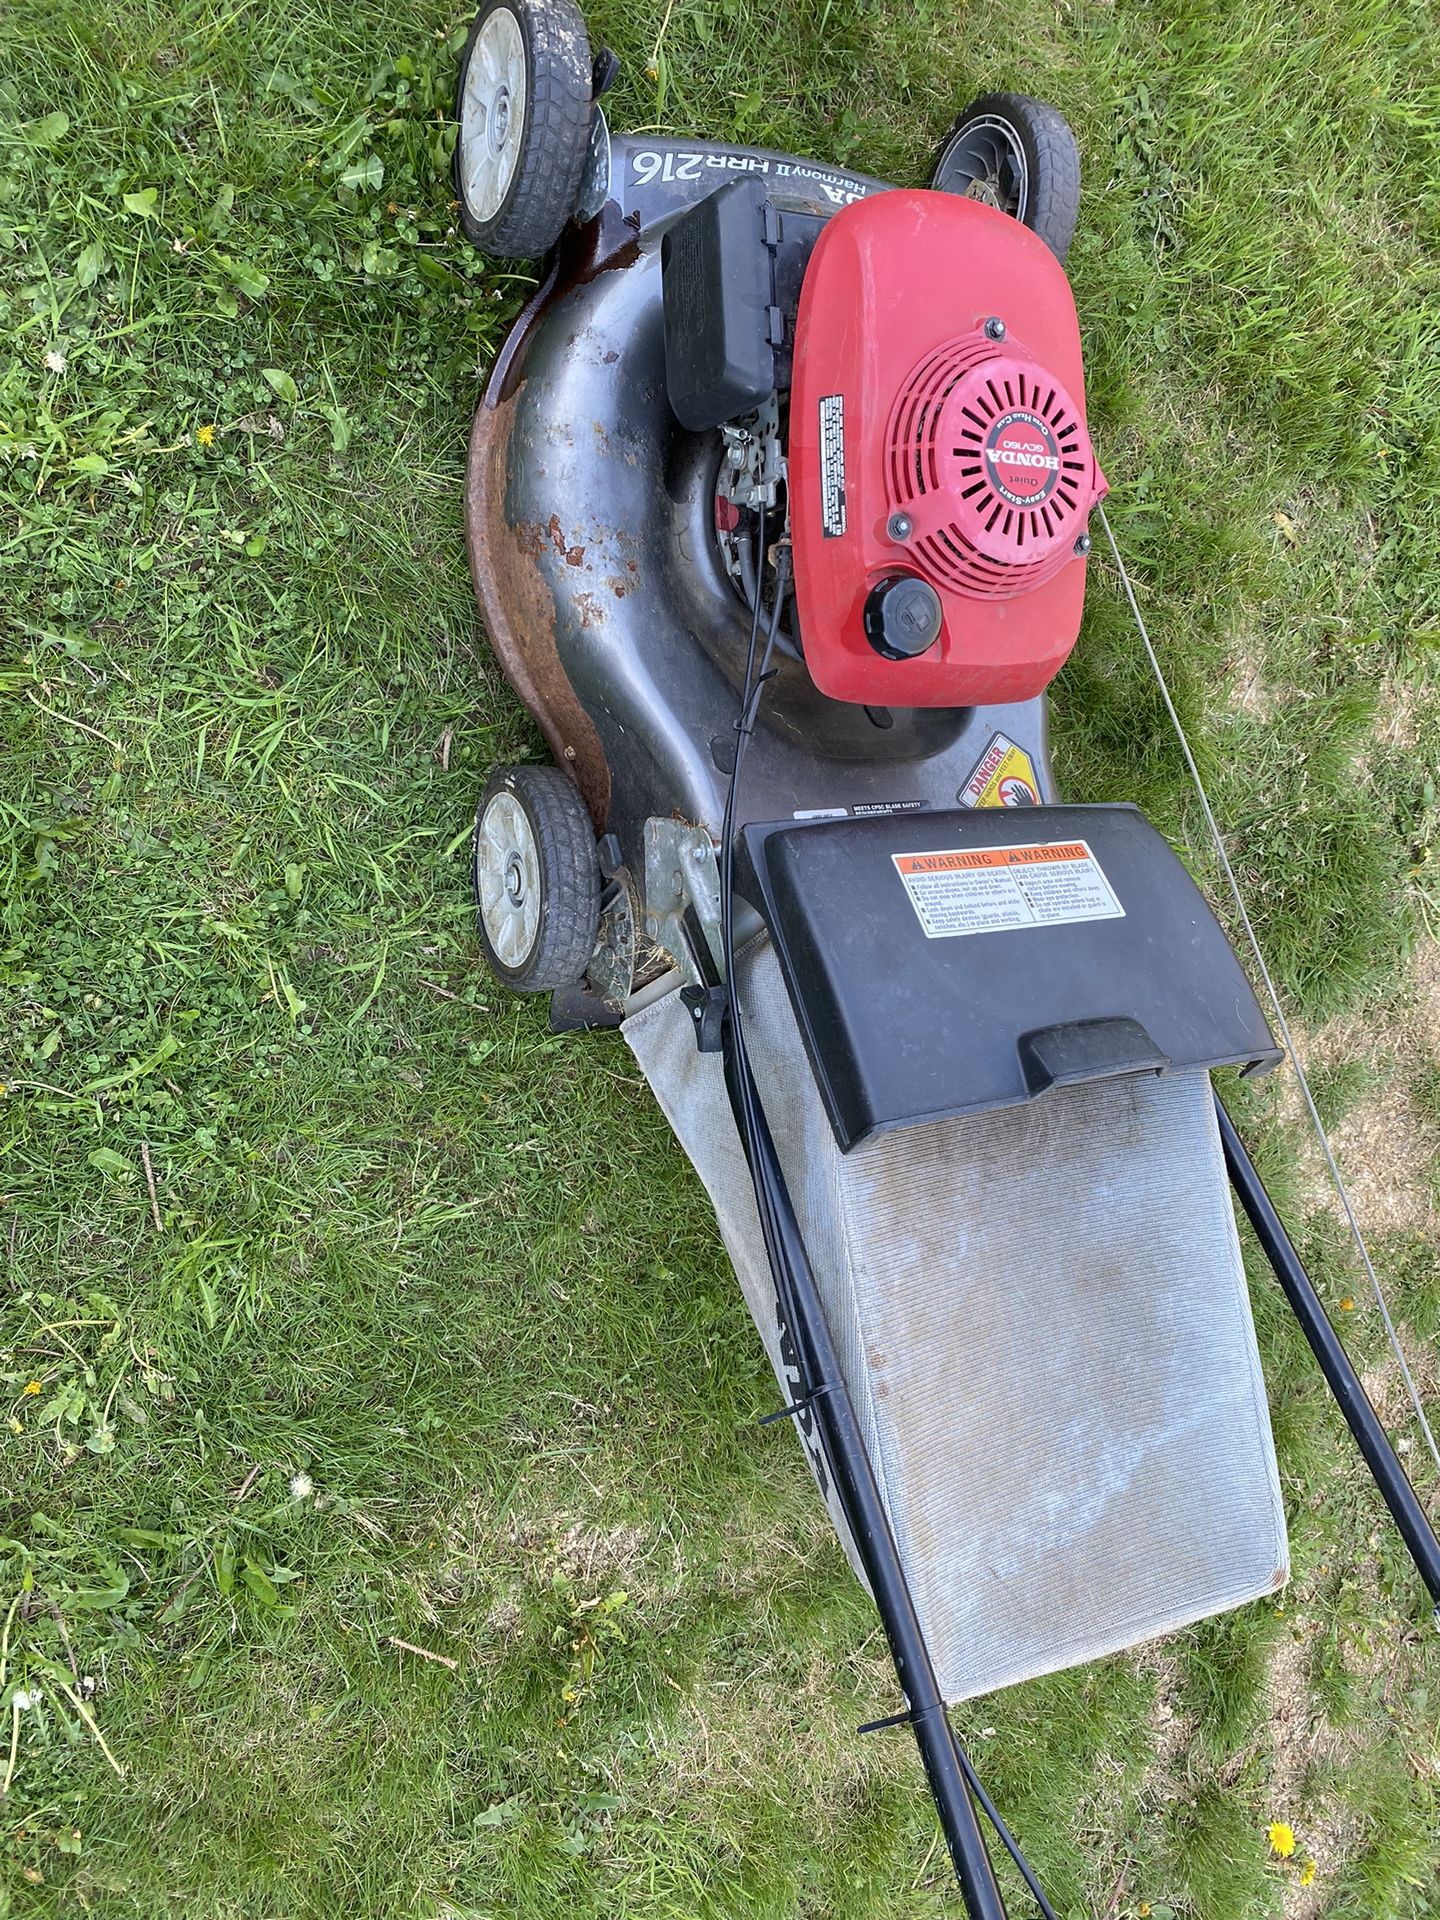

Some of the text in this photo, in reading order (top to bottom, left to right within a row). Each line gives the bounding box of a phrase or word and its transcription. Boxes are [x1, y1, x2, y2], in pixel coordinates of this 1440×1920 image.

[628, 150, 704, 187] 216
[705, 154, 769, 173] HRR
[791, 164, 866, 195] Harmony
[1003, 440, 1044, 453] GCV160
[985, 448, 1059, 470] HONDA
[1009, 475, 1038, 487] Quiet
[999, 485, 1046, 504] Easy-Start
[968, 746, 1005, 797] DANGER
[985, 782, 997, 798] HANDS
[1000, 762, 1009, 775] FEET
[923, 853, 993, 868] WARNING
[1020, 846, 1085, 860] WARNING
